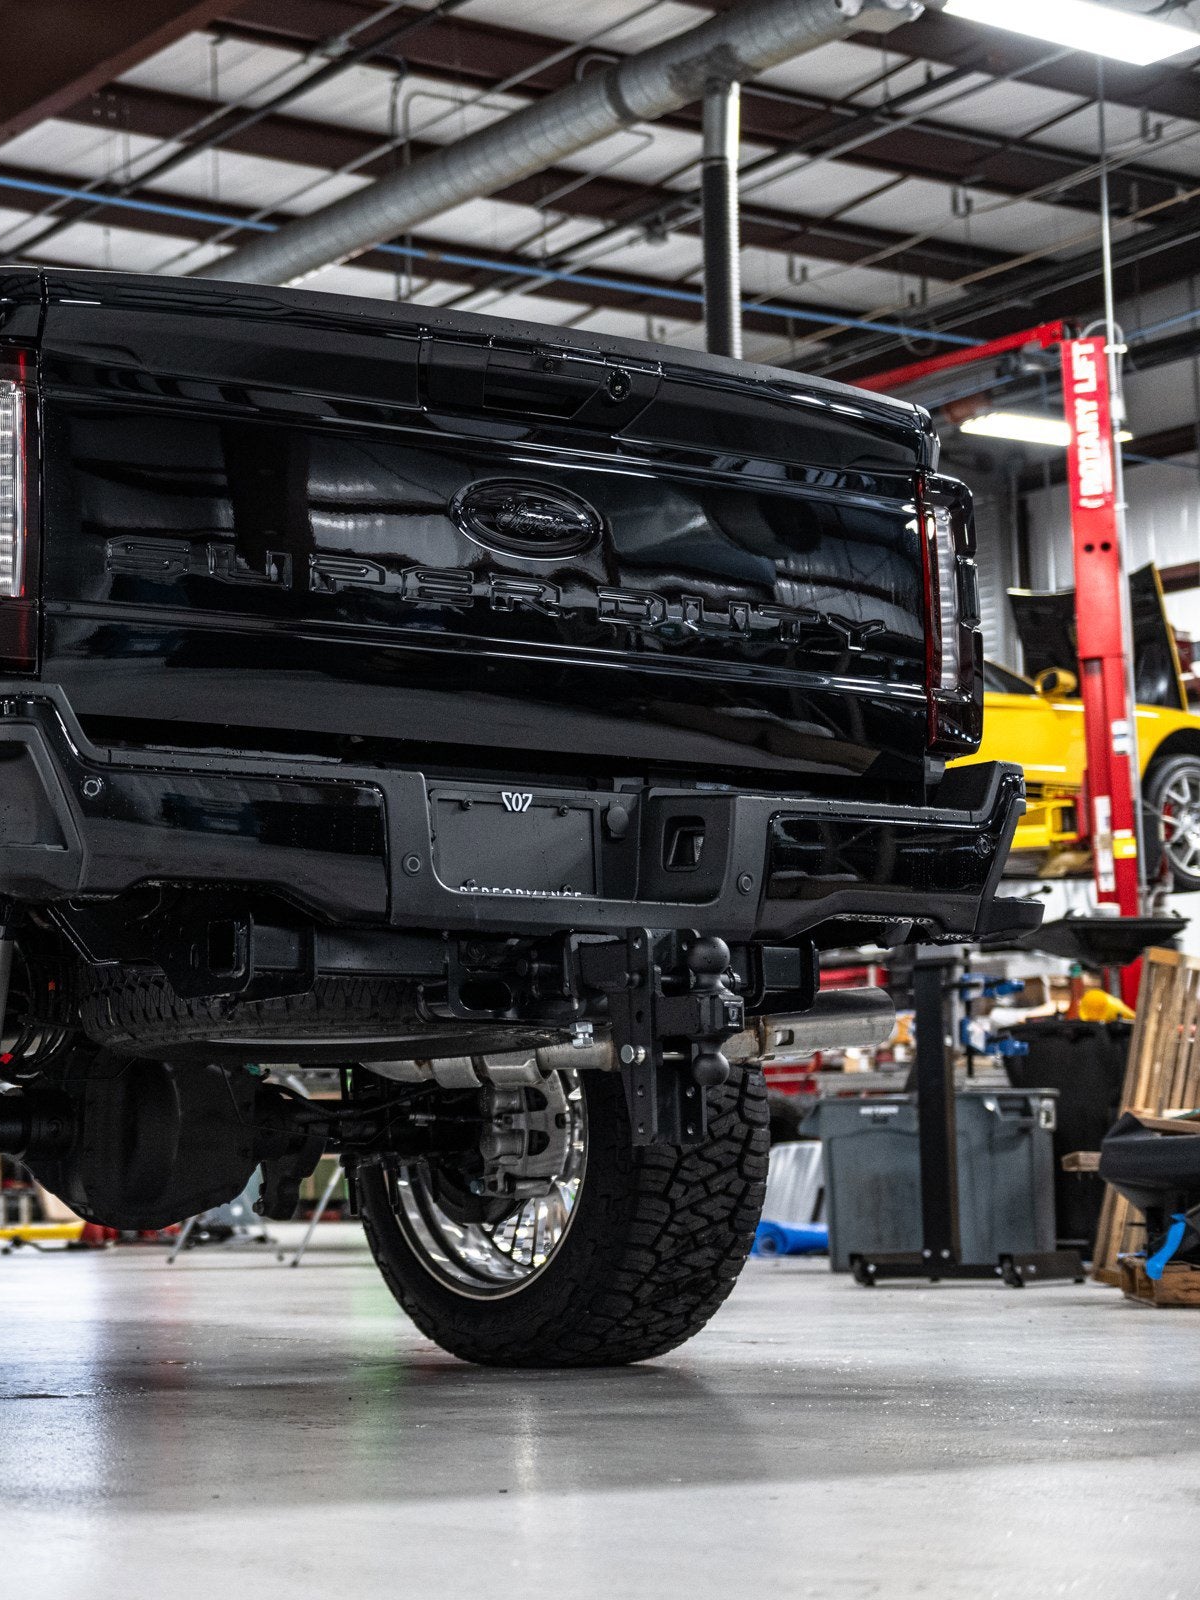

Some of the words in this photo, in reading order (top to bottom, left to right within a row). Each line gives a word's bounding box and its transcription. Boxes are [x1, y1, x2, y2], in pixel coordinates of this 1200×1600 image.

[1071, 341, 1097, 393] LIFT
[105, 535, 563, 614] SUPER
[597, 585, 887, 651] DUTY
